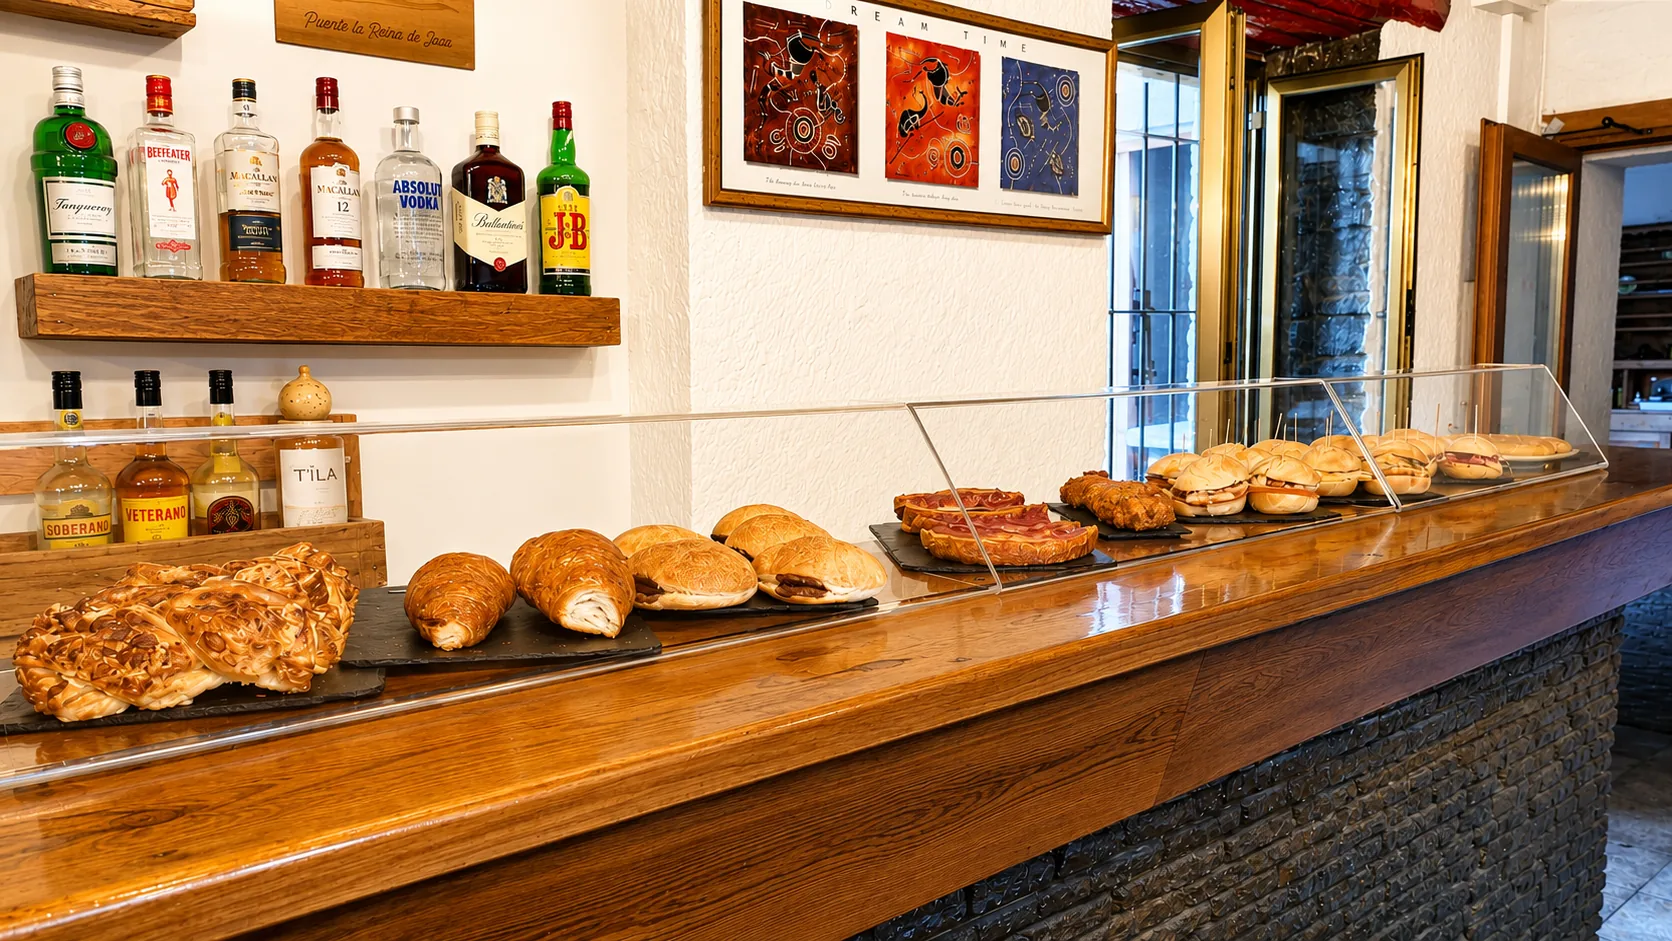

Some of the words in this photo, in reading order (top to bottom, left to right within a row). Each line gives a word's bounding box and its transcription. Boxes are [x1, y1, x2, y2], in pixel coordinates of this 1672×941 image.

[304, 11, 349, 32] Puente
[351, 20, 365, 35] la
[406, 29, 421, 43] de
[146, 146, 191, 162] BEEFEATER
[230, 171, 278, 183] MACALLAN
[316, 184, 361, 198] MACALLAN
[392, 179, 442, 197] ABSOLUT
[337, 201, 350, 213] 12
[399, 194, 440, 211] VODKA
[125, 505, 186, 522] VETERANO
[46, 519, 109, 536] SOBERANO
